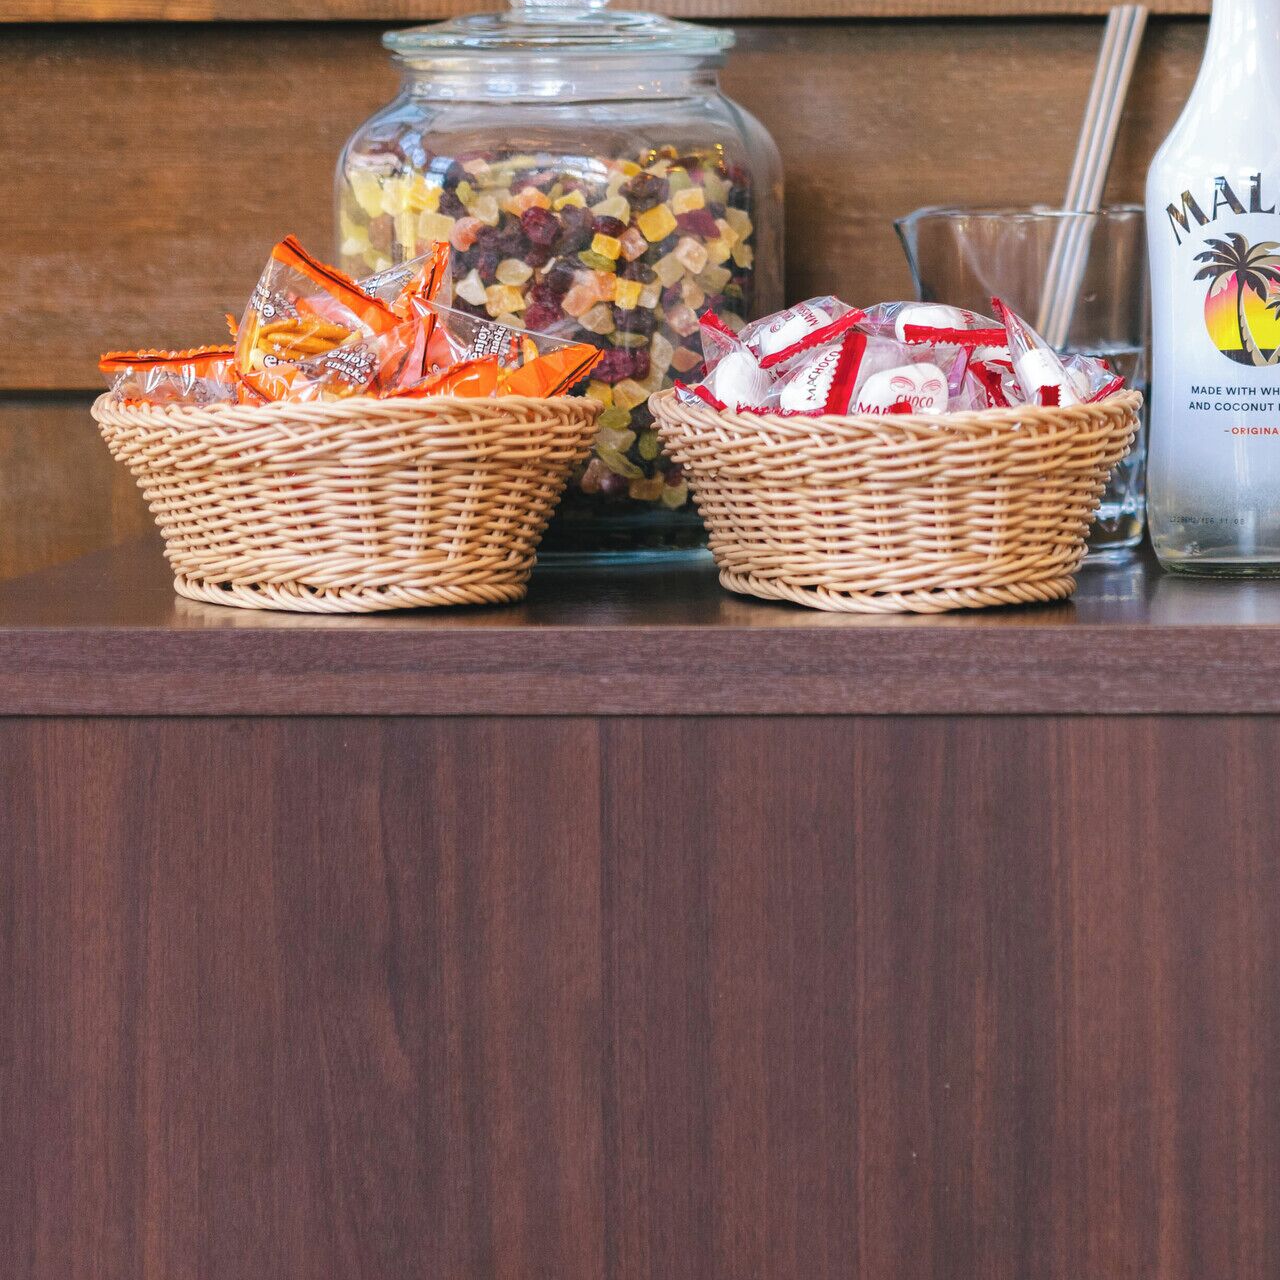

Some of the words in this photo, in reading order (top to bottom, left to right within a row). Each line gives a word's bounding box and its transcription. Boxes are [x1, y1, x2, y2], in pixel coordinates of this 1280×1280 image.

[326, 349, 371, 371] enjoy
[324, 359, 368, 385] snacks
[1191, 386, 1222, 395] MADE
[1225, 387, 1257, 396] WITH
[1188, 401, 1211, 411] AND
[1214, 402, 1275, 412] COCONUT
